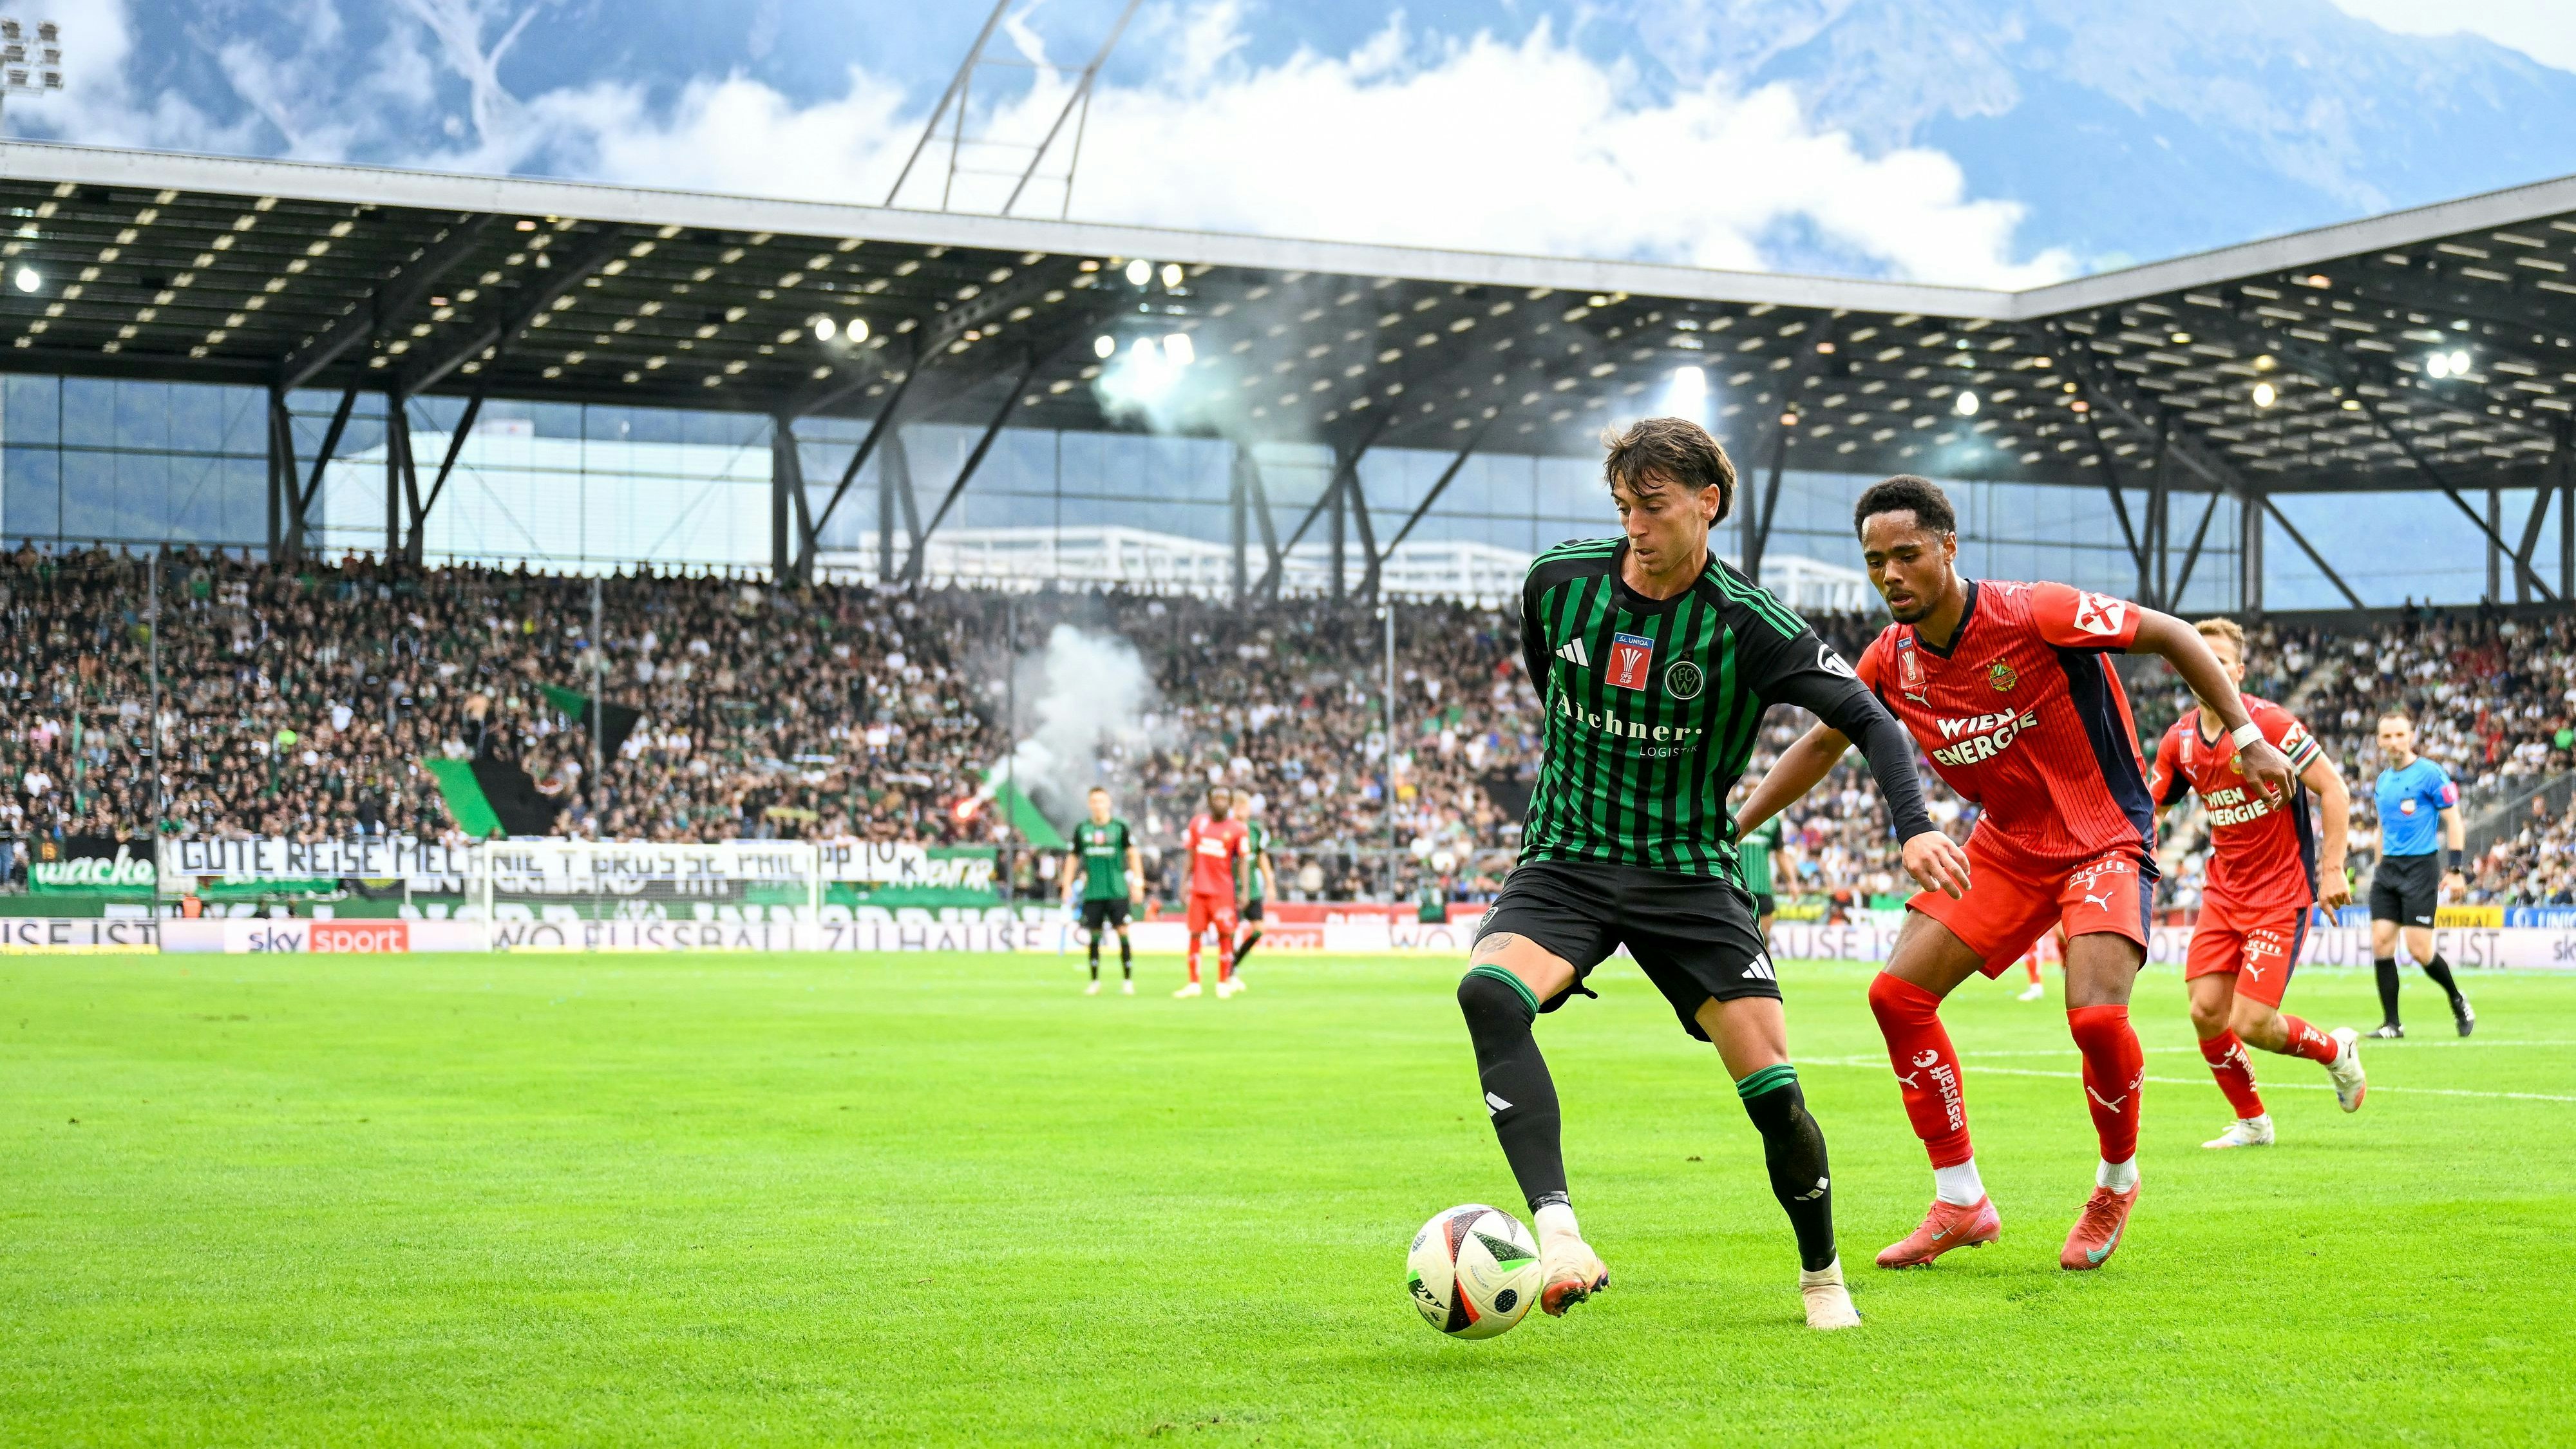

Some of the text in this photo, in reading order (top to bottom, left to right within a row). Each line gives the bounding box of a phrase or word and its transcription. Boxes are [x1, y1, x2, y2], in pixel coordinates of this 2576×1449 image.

[1628, 638, 1649, 647] UNIQA
[1677, 667, 1694, 682] FC
[1937, 708, 2016, 740] WIEN
[1932, 710, 2038, 766] ENERGIE
[1640, 745, 1698, 757] LOGISTIK
[2201, 786, 2246, 808] WIEN
[2207, 799, 2269, 826] NERGIE
[182, 838, 274, 871] GUTE
[286, 840, 380, 873] REISE
[2069, 860, 2128, 887] ZUCKER
[2437, 913, 2490, 928] MIRAL
[249, 927, 303, 952] sky
[315, 928, 402, 952] sport
[1771, 931, 1857, 960] AUSE
[2246, 940, 2282, 956] UCKER
[1929, 1063, 1964, 1132] easystaff
